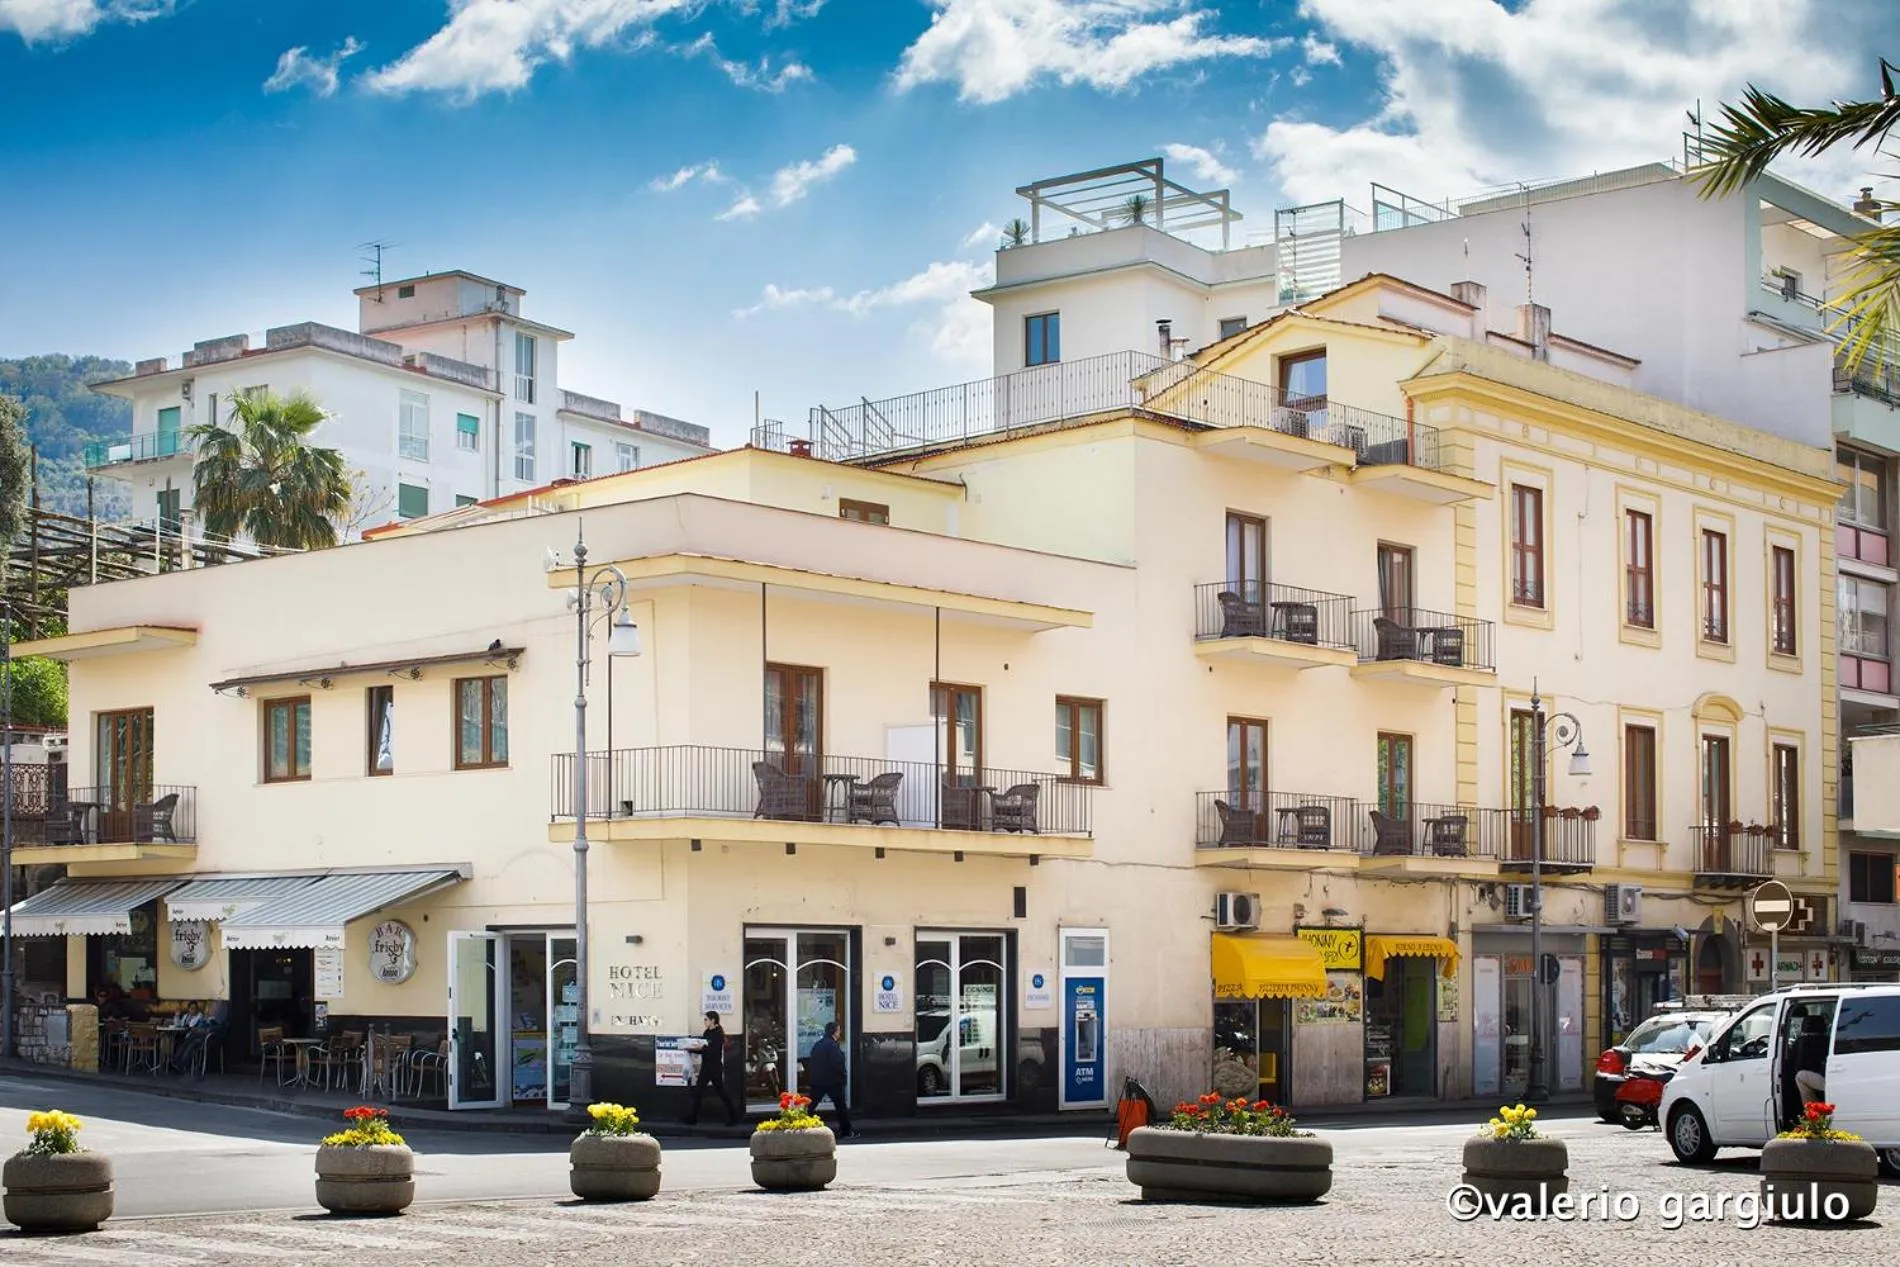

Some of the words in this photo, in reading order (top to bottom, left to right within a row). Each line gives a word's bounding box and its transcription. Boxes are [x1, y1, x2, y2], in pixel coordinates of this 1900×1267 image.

[609, 965, 662, 980] HOTEL
[610, 982, 663, 1000] NICE
[1217, 983, 1244, 993] PIZZA
[878, 1001, 900, 1009] NICE
[1076, 1067, 1094, 1076] ATM
